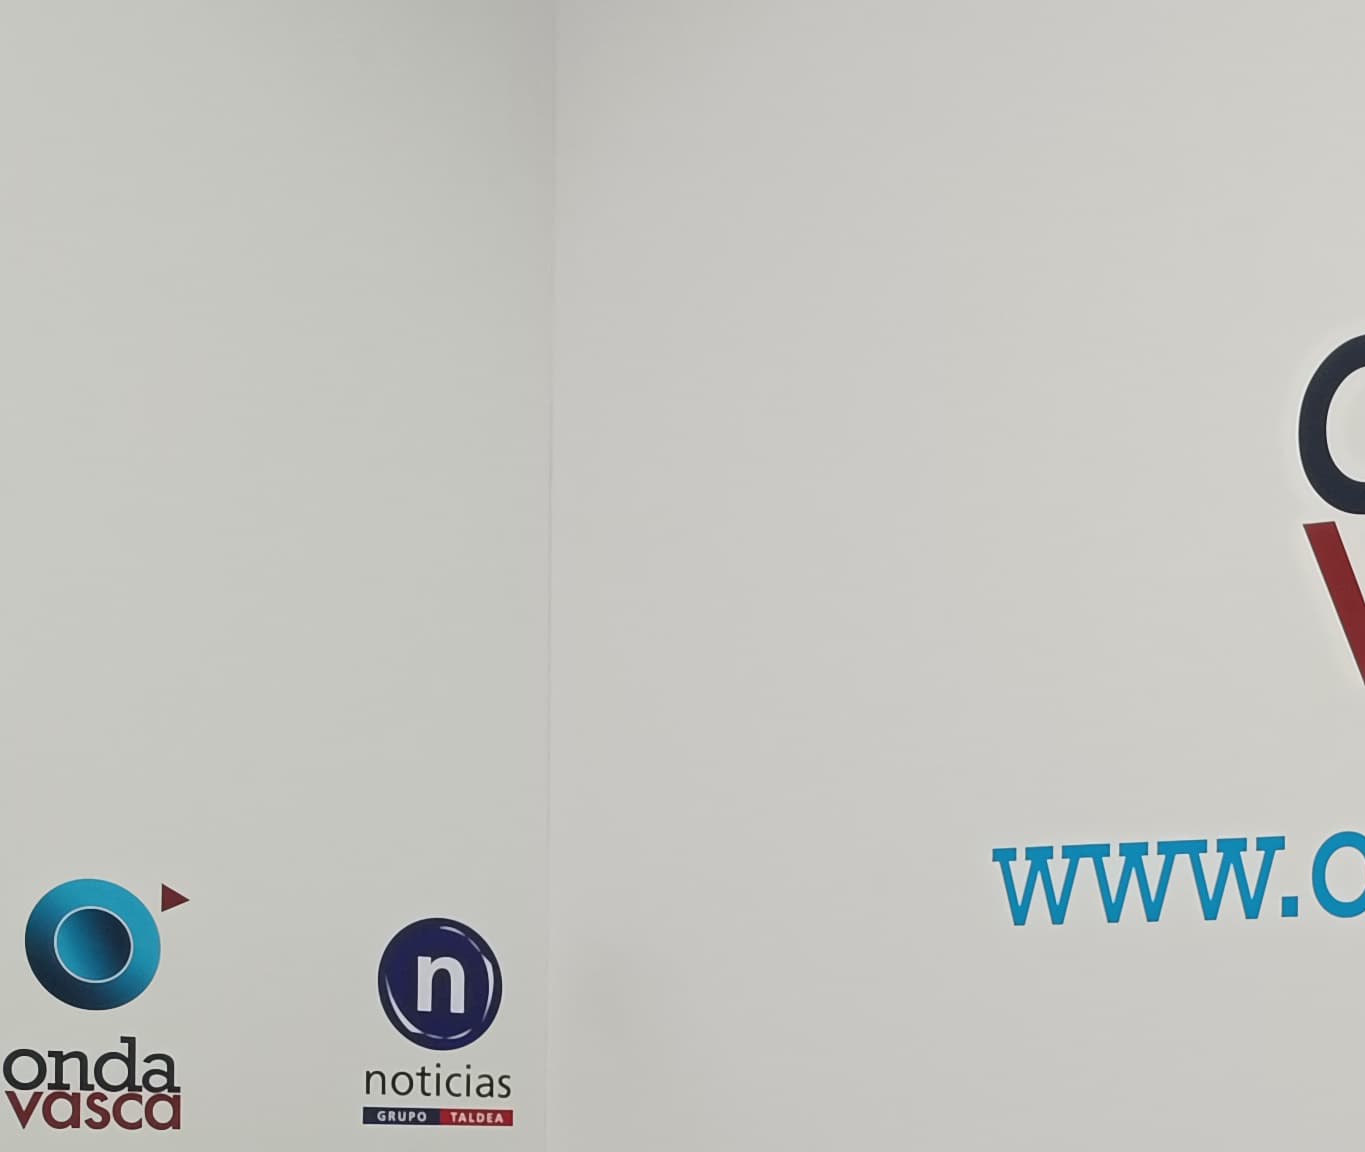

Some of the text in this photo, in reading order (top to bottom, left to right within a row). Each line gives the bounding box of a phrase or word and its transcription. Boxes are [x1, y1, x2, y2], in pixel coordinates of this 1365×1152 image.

[417, 956, 465, 1014] n
[2, 1035, 181, 1094] onda
[365, 1062, 511, 1099] noticias
[4, 1091, 181, 1131] vasca
[376, 1110, 504, 1124] GRUPO TALDEA
